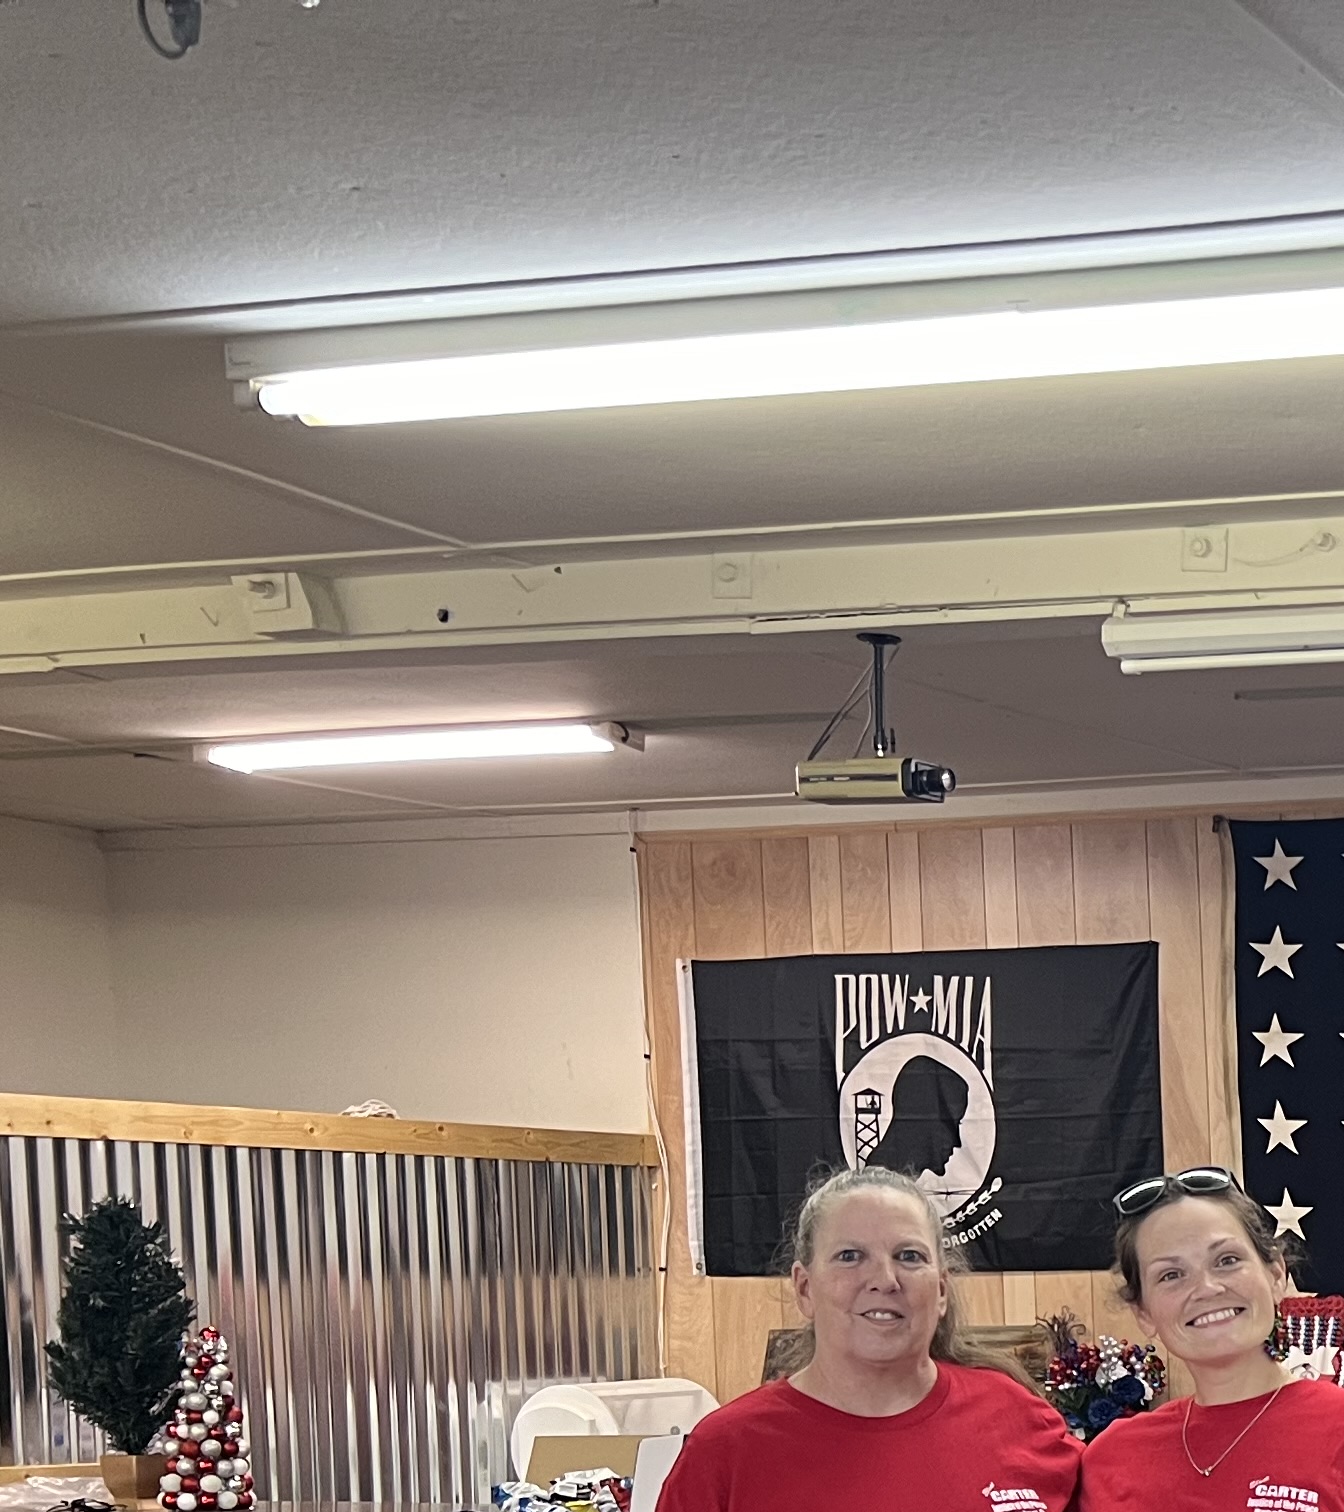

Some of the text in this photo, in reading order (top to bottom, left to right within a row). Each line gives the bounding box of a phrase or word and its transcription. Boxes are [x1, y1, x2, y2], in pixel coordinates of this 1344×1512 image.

[834, 974, 994, 1092] POW MIA
[941, 1208, 1003, 1249] ORGOTTEN
[1255, 1484, 1319, 1504] CARTER
